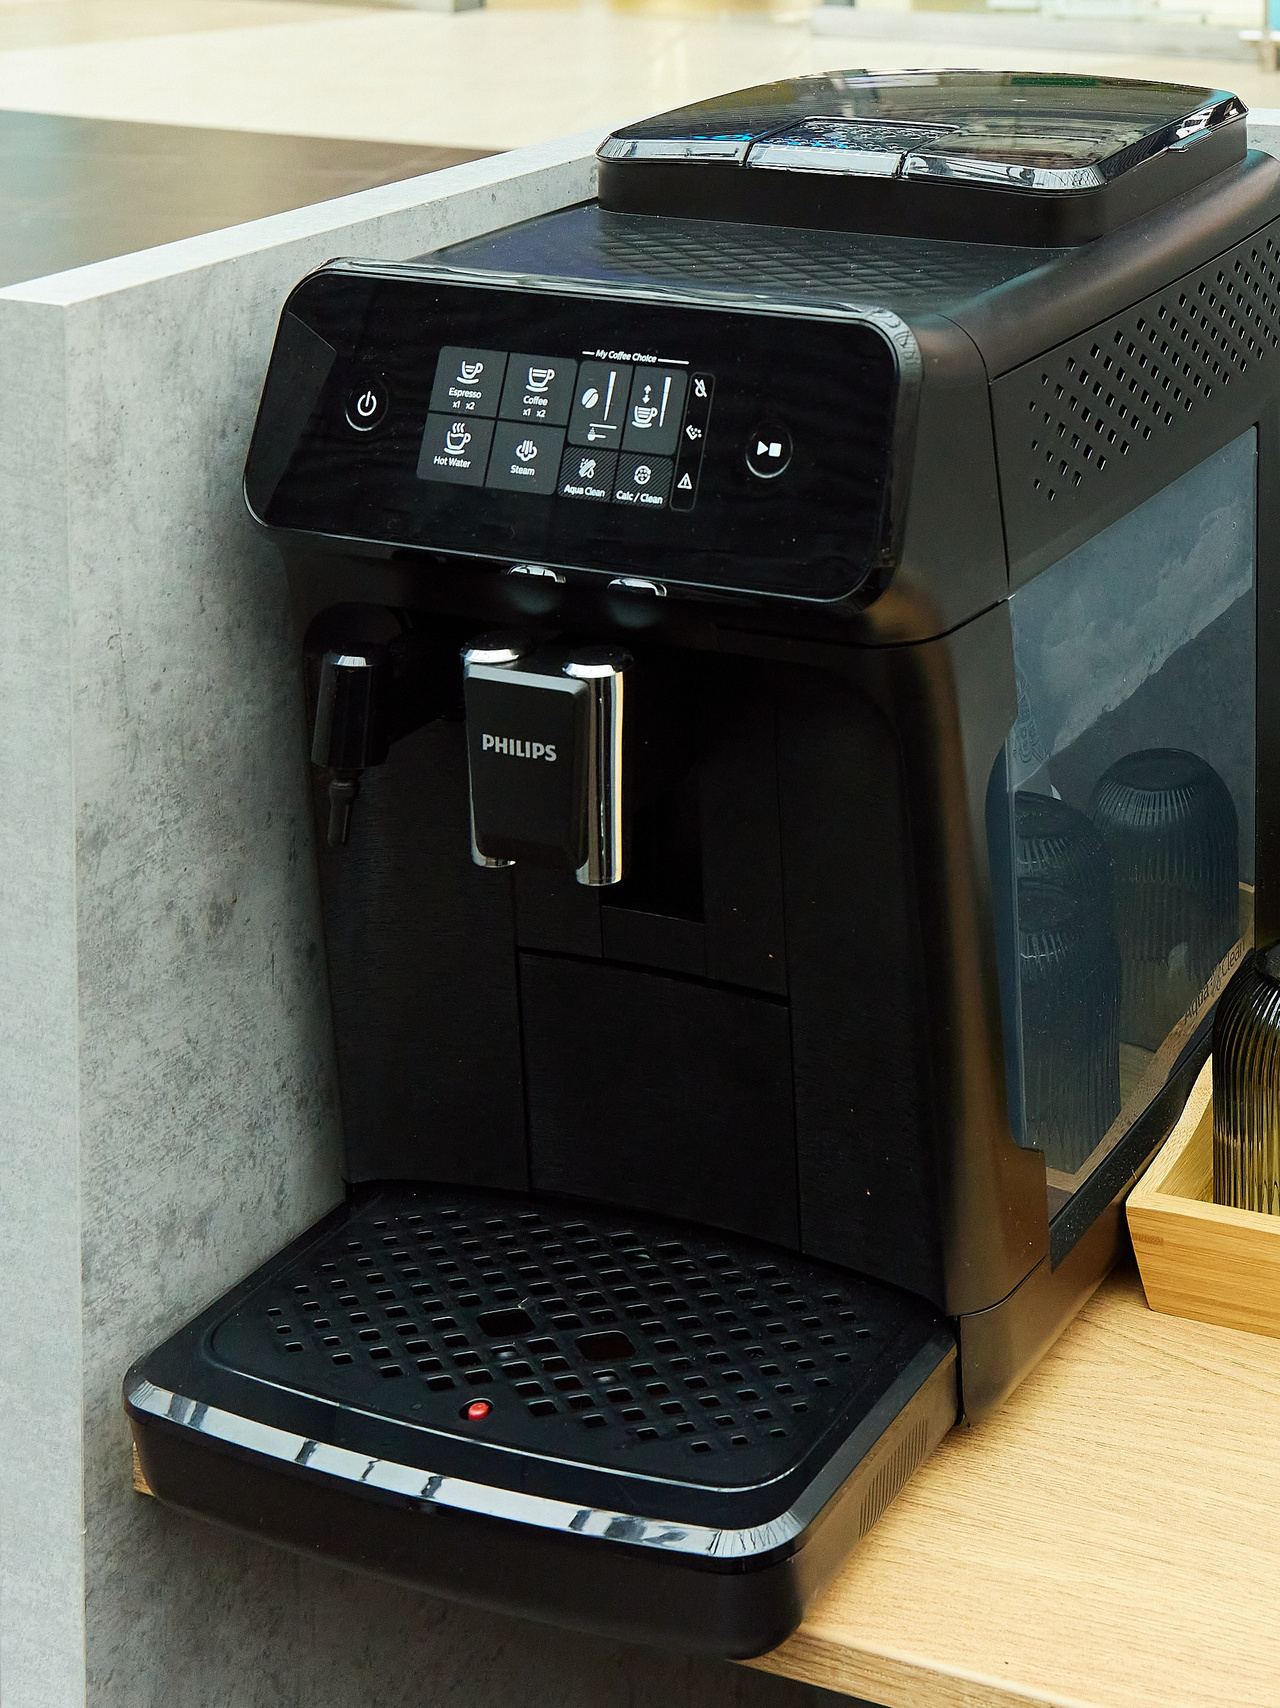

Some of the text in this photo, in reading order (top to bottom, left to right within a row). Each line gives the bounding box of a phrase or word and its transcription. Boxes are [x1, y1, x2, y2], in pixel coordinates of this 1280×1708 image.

[595, 349, 657, 363] My Coffee Choice
[448, 387, 482, 399] Espresso
[452, 400, 476, 410] x1 x2
[523, 395, 548, 406] Coffee
[522, 407, 547, 418] x1 x2
[433, 455, 471, 468] Hot Water
[510, 464, 535, 476] Steam
[564, 484, 606, 498] Aqua Clean
[616, 490, 634, 501] Calc
[640, 493, 663, 505] Clean
[482, 733, 558, 762] PHILIPS
[1183, 939, 1246, 1026] Aqua Clean
